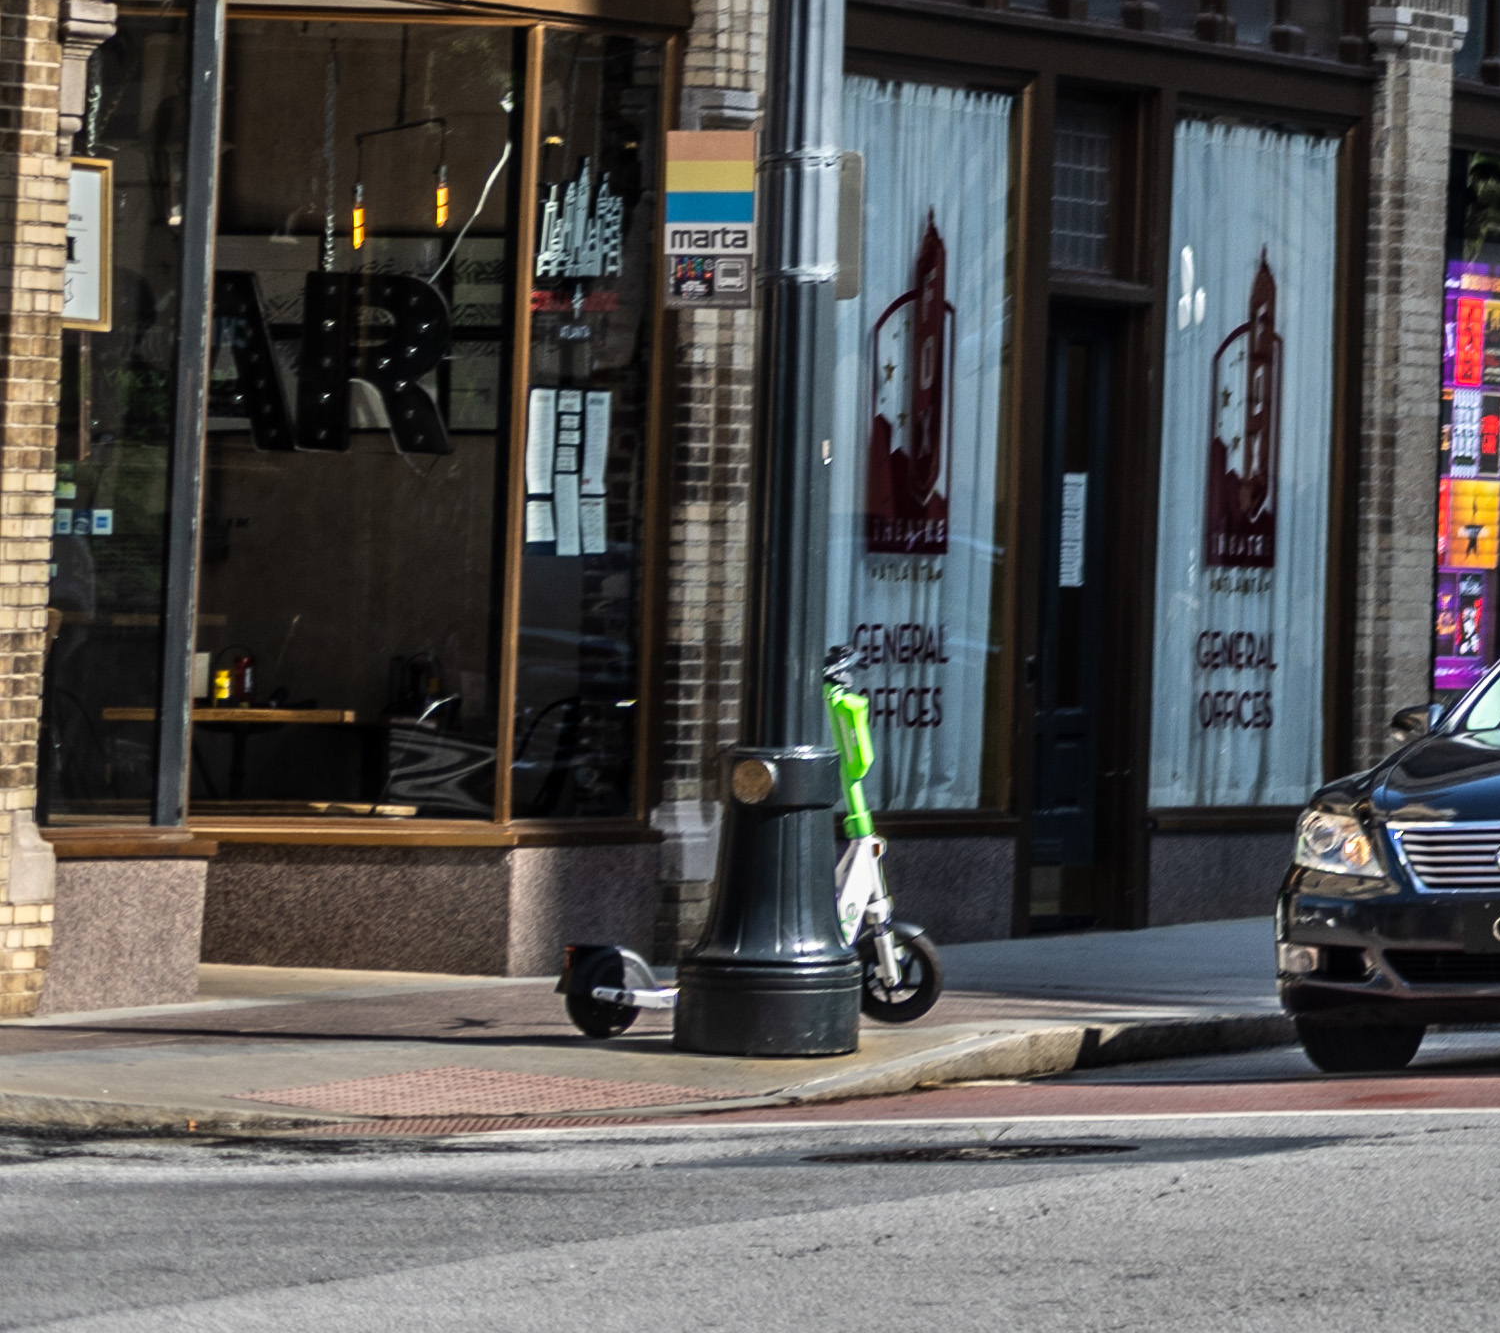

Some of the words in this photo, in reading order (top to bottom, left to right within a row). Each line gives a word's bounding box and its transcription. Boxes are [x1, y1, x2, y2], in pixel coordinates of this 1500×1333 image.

[671, 226, 748, 250] marta
[852, 621, 949, 666] GENERAL
[1195, 629, 1278, 672] GENERAL
[1197, 690, 1275, 731] OFFICES
